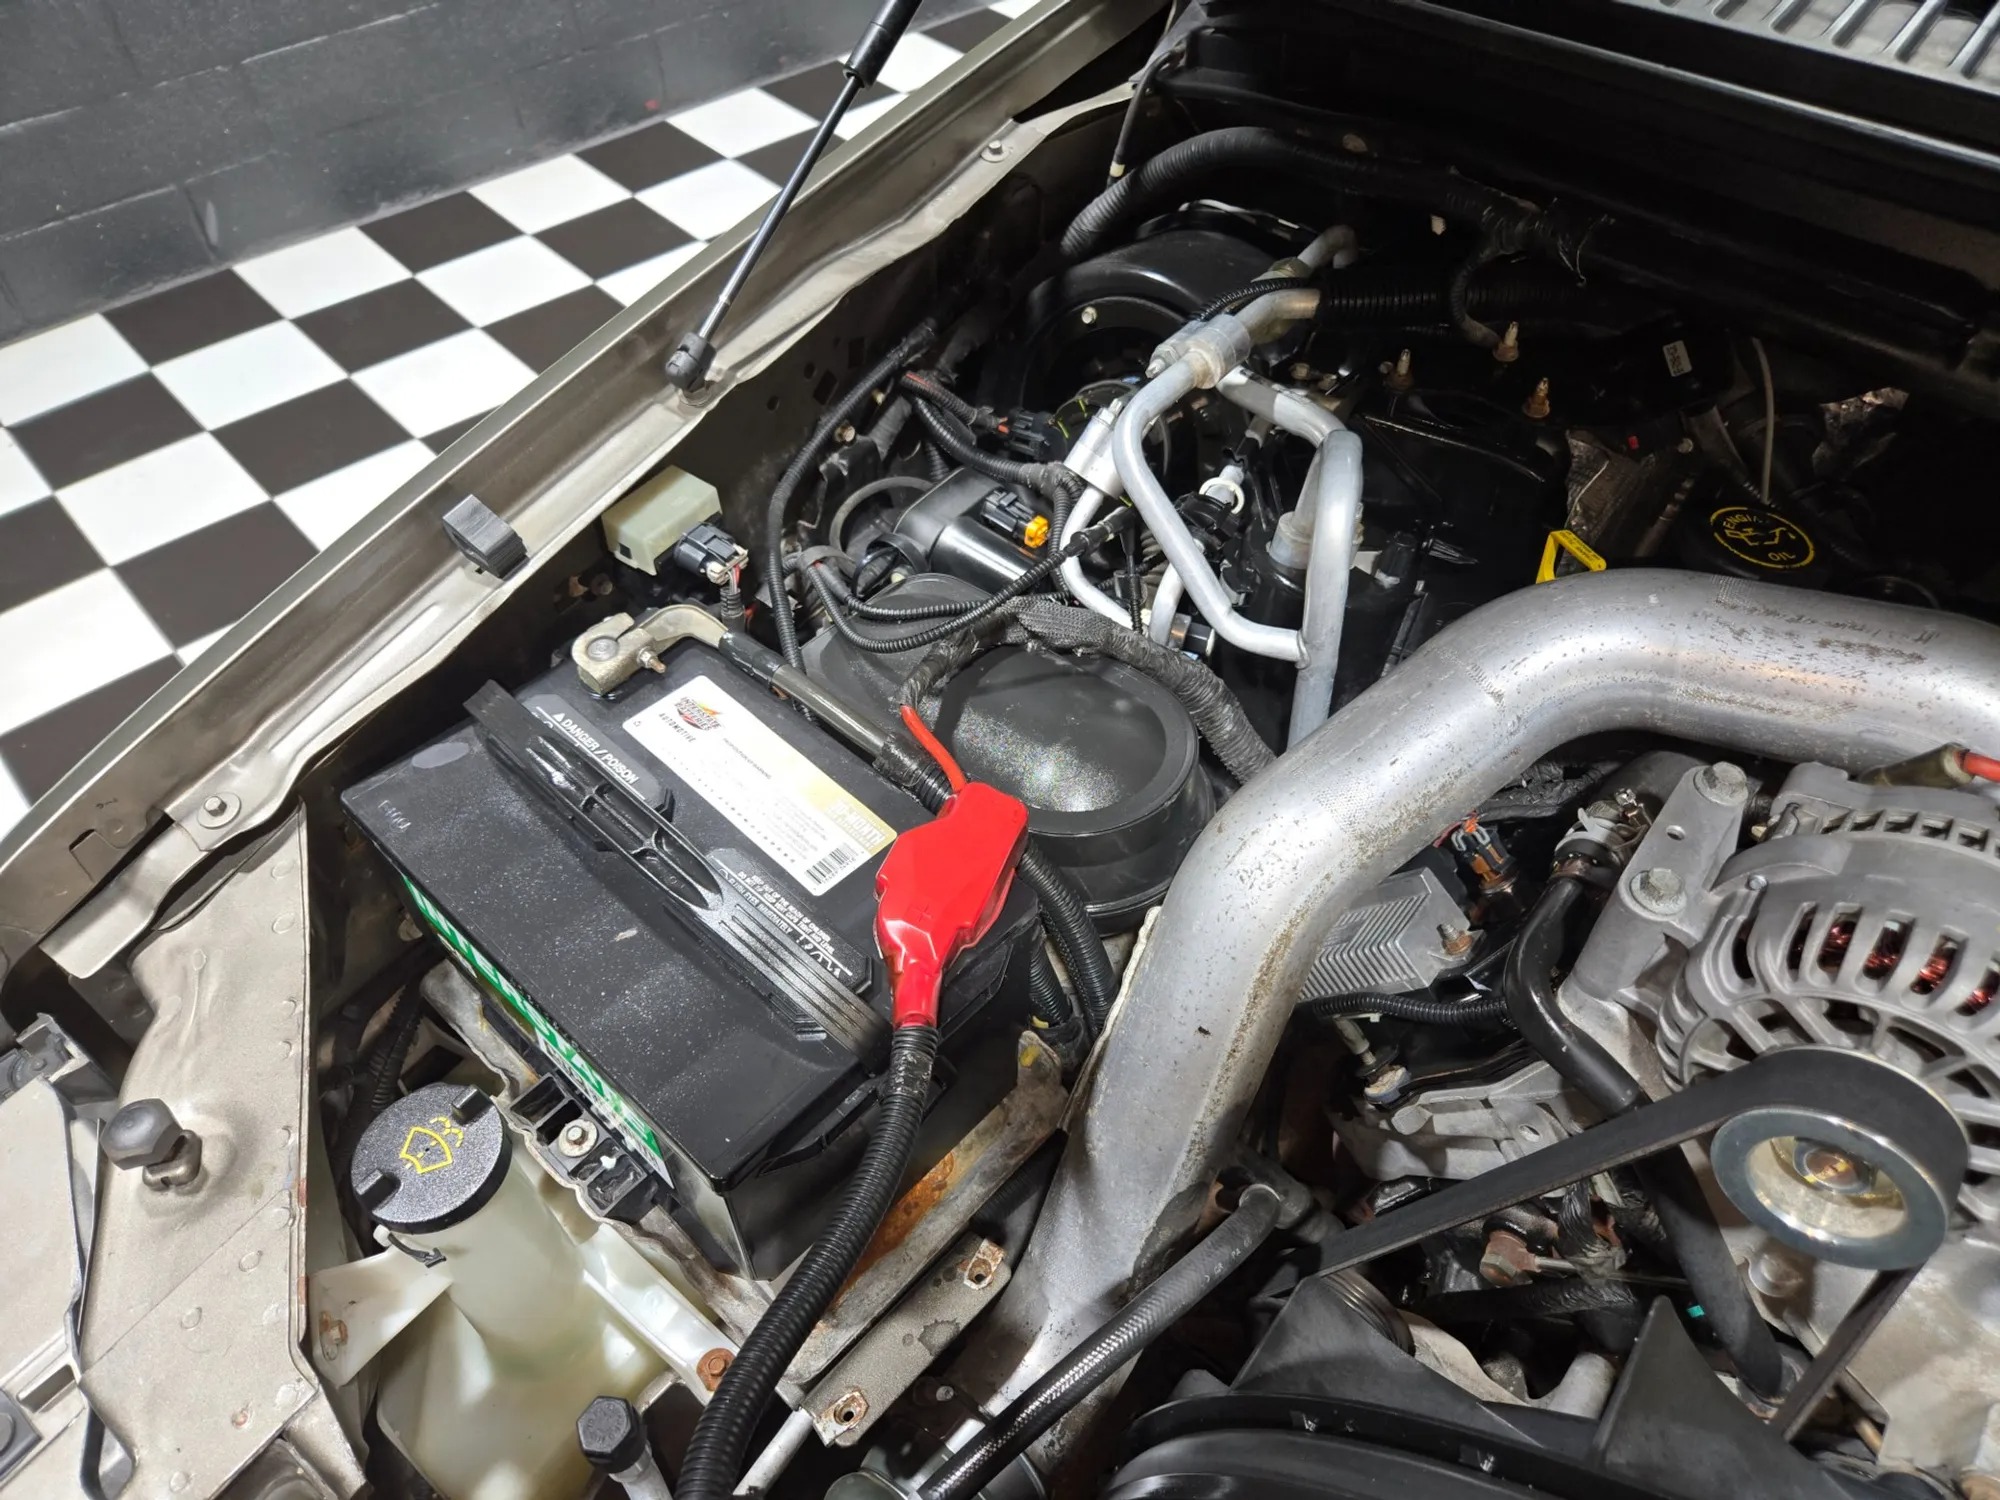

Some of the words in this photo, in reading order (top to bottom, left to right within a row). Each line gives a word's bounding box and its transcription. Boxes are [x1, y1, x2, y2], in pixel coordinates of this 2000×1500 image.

[1767, 551, 1797, 562] OIL
[658, 712, 697, 744] AUTOMOTIVE
[673, 702, 712, 732] BATTERIES
[680, 696, 724, 729] INTERSTATE
[561, 718, 600, 751] DANGER
[601, 753, 640, 785] POISON
[744, 891, 760, 906] EYES
[757, 903, 794, 935] IMMEDIATELY
